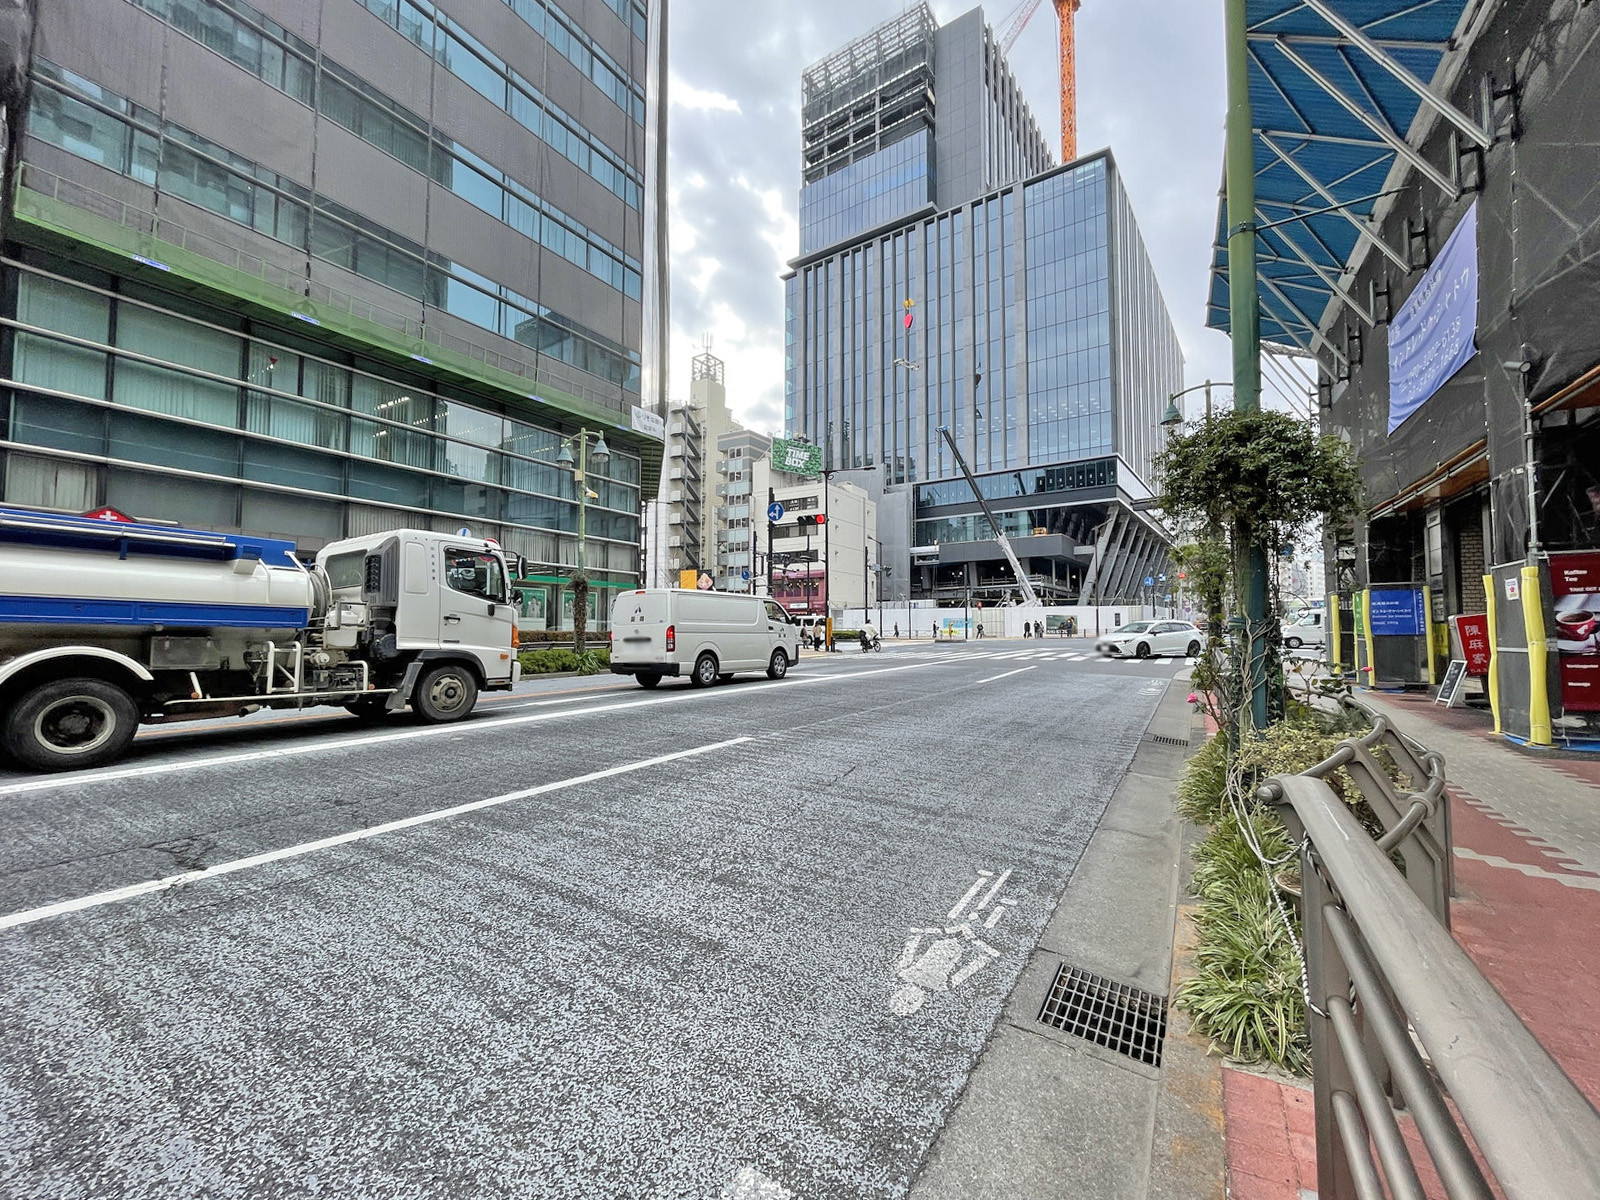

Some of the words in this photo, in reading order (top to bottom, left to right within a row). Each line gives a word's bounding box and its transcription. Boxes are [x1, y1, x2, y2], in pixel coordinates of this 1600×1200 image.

[786, 447, 811, 462] TIME
[784, 456, 805, 469] BOX
[1464, 624, 1488, 665] 陳麻家
